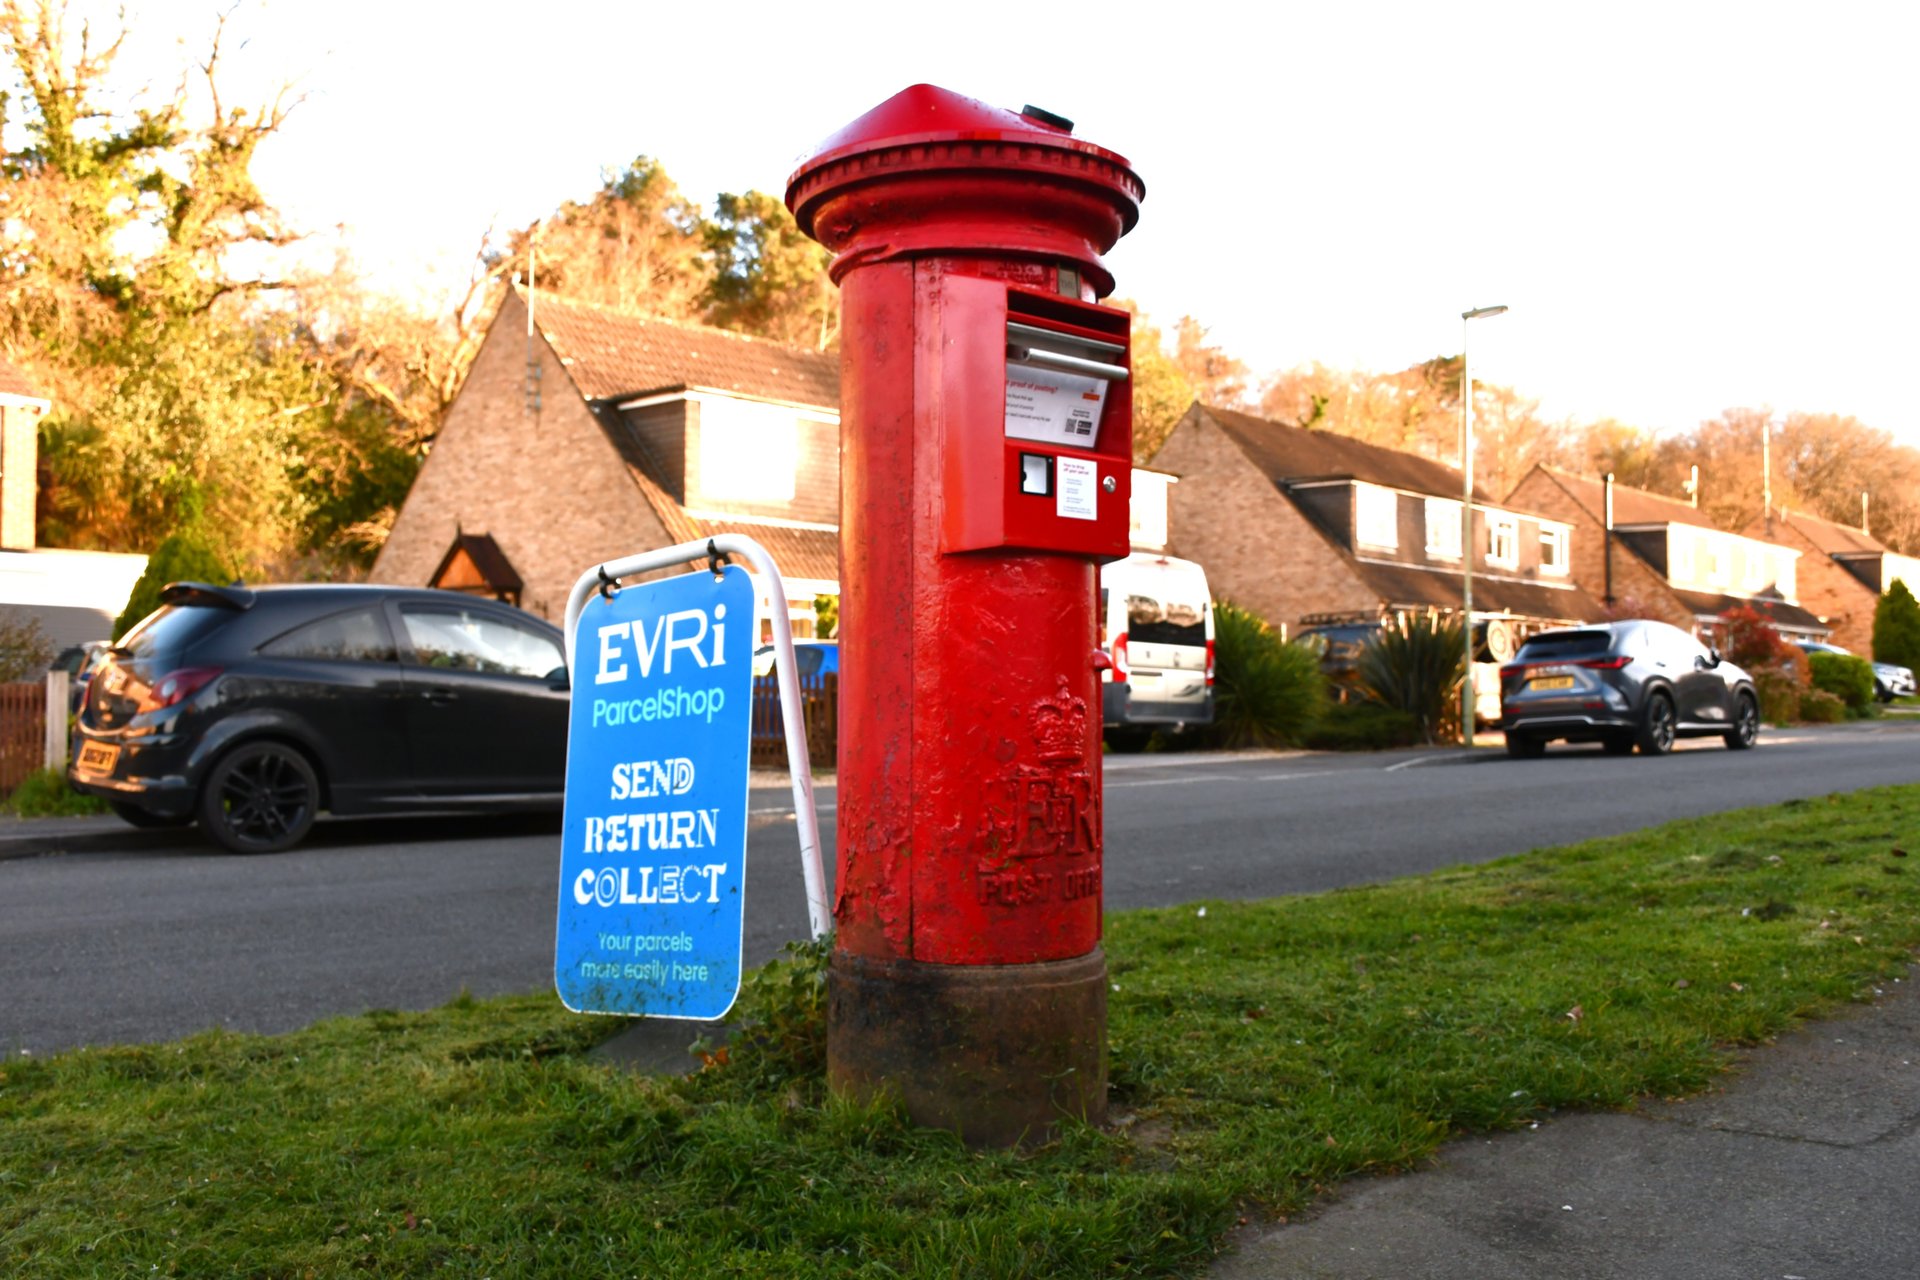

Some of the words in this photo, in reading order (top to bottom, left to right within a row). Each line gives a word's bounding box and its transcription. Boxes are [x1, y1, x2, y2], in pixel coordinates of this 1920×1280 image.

[593, 685, 725, 727] ParcelShop
[611, 757, 695, 801] SEND
[582, 808, 720, 854] RETURN
[573, 863, 727, 908] COLLECT
[598, 932, 632, 951] Your
[634, 930, 693, 957] parcels
[581, 962, 620, 979] more
[624, 960, 669, 987] easily
[672, 960, 708, 981] here
